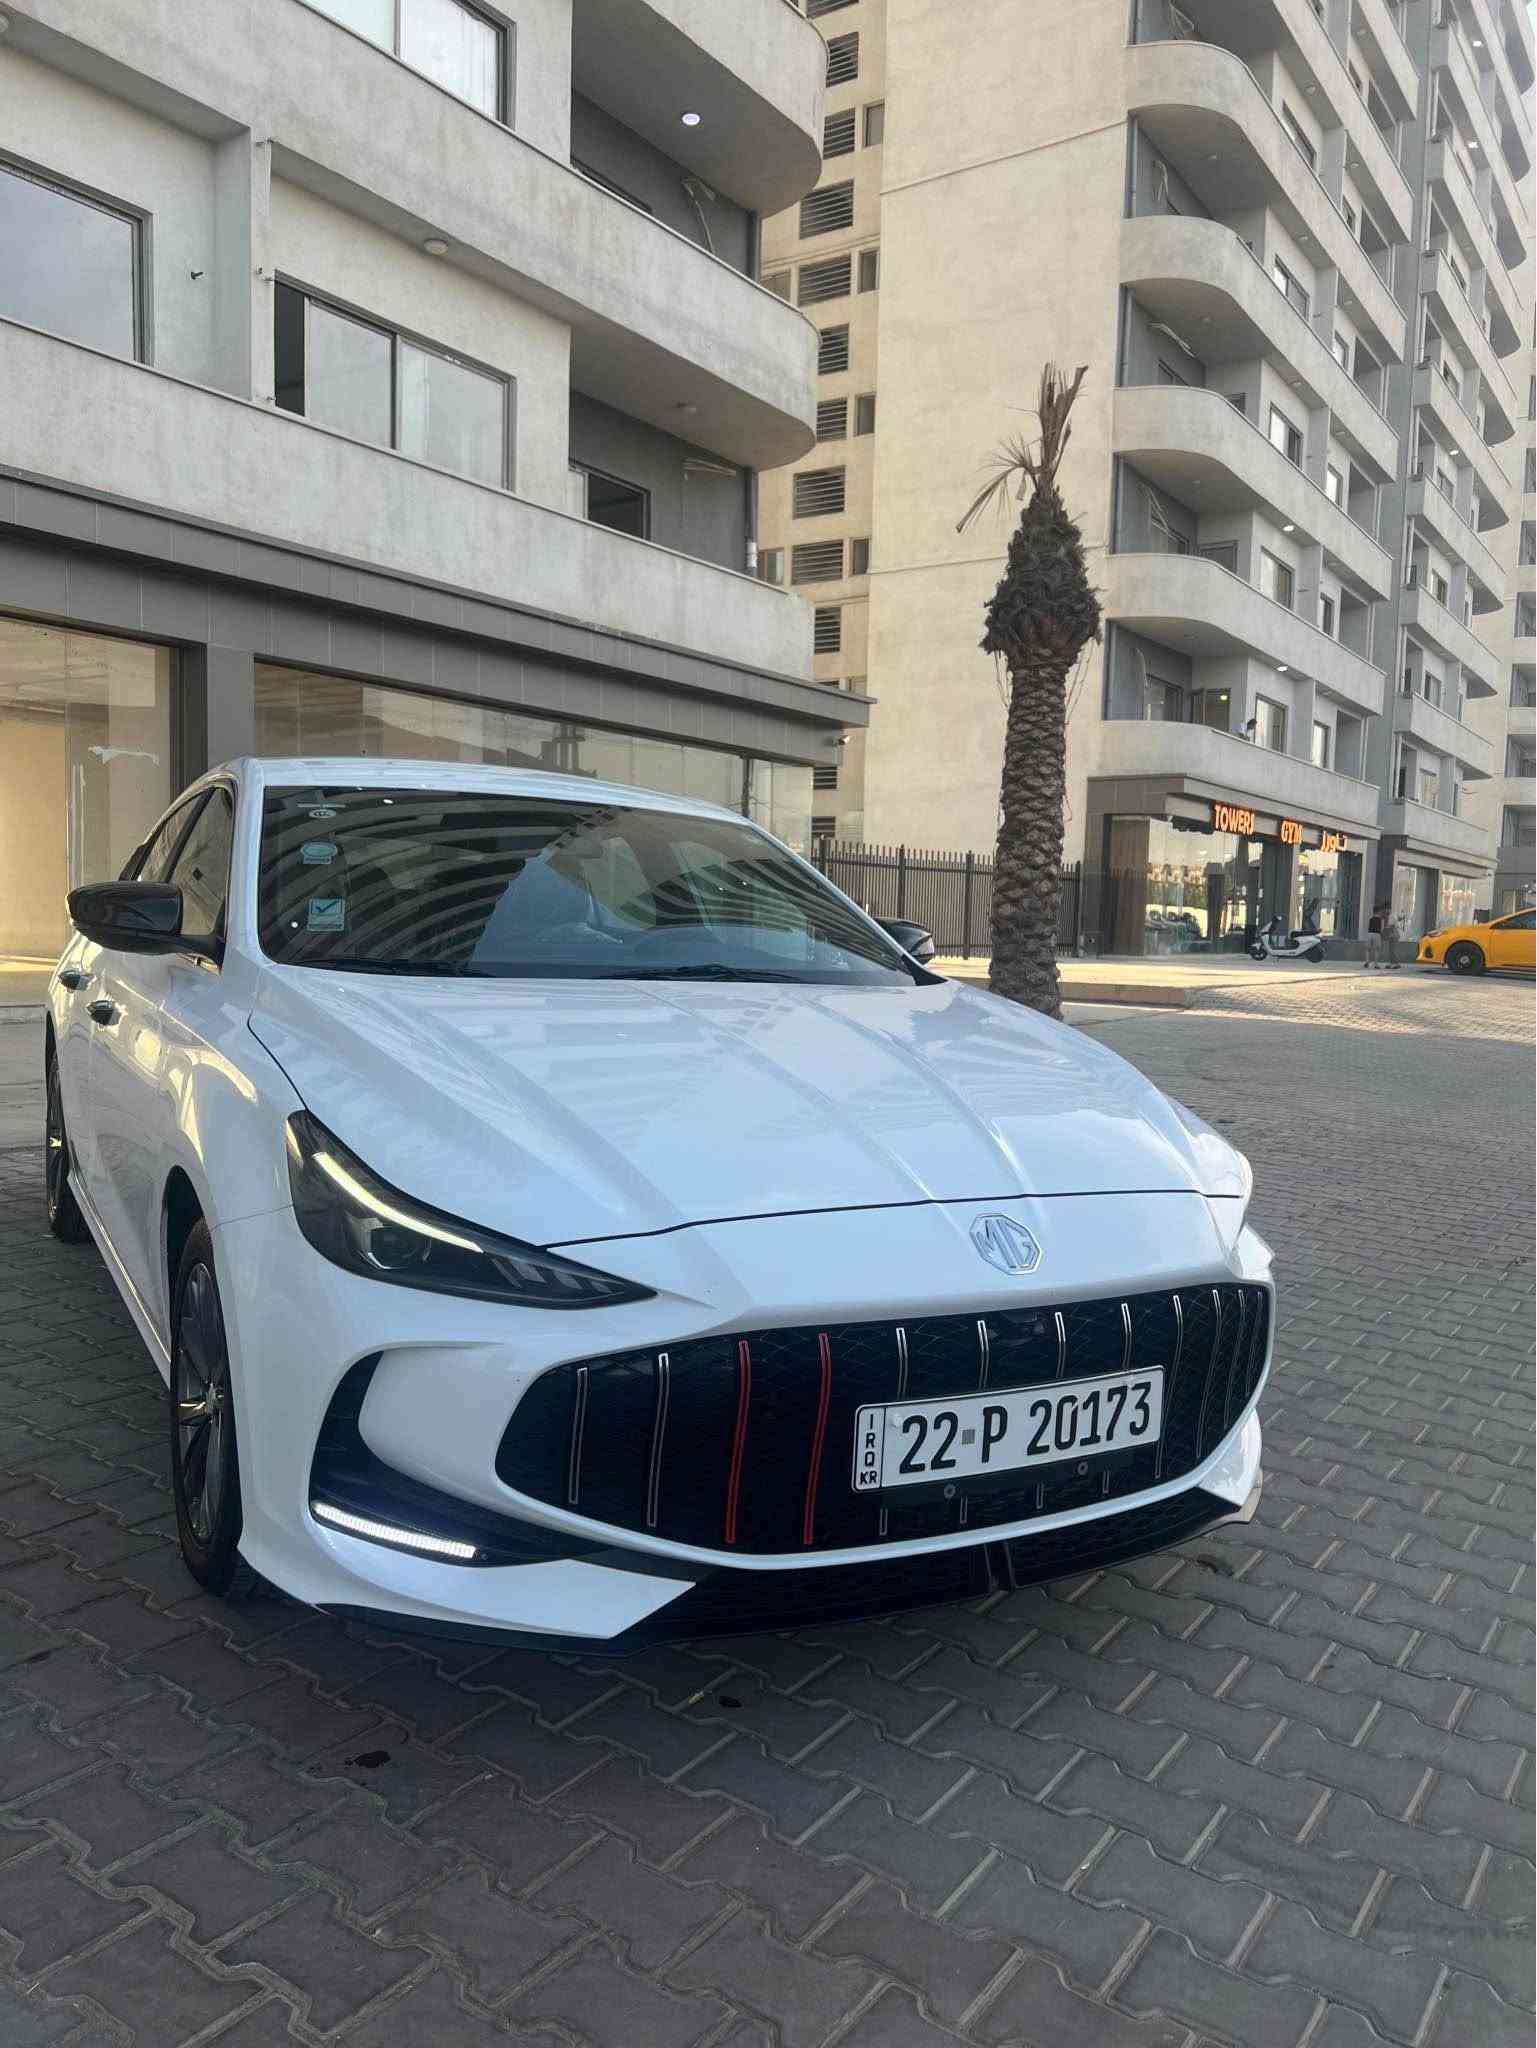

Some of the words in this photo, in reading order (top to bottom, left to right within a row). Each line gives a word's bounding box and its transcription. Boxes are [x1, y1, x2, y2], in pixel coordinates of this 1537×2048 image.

[1214, 804, 1256, 836] TOWERS
[1281, 820, 1304, 844] GYM
[975, 1219, 1037, 1269] MG
[899, 1411, 959, 1475] 22
[981, 1405, 1008, 1464] P
[1026, 1381, 1152, 1456] 20173
[860, 1470, 877, 1485] KR
